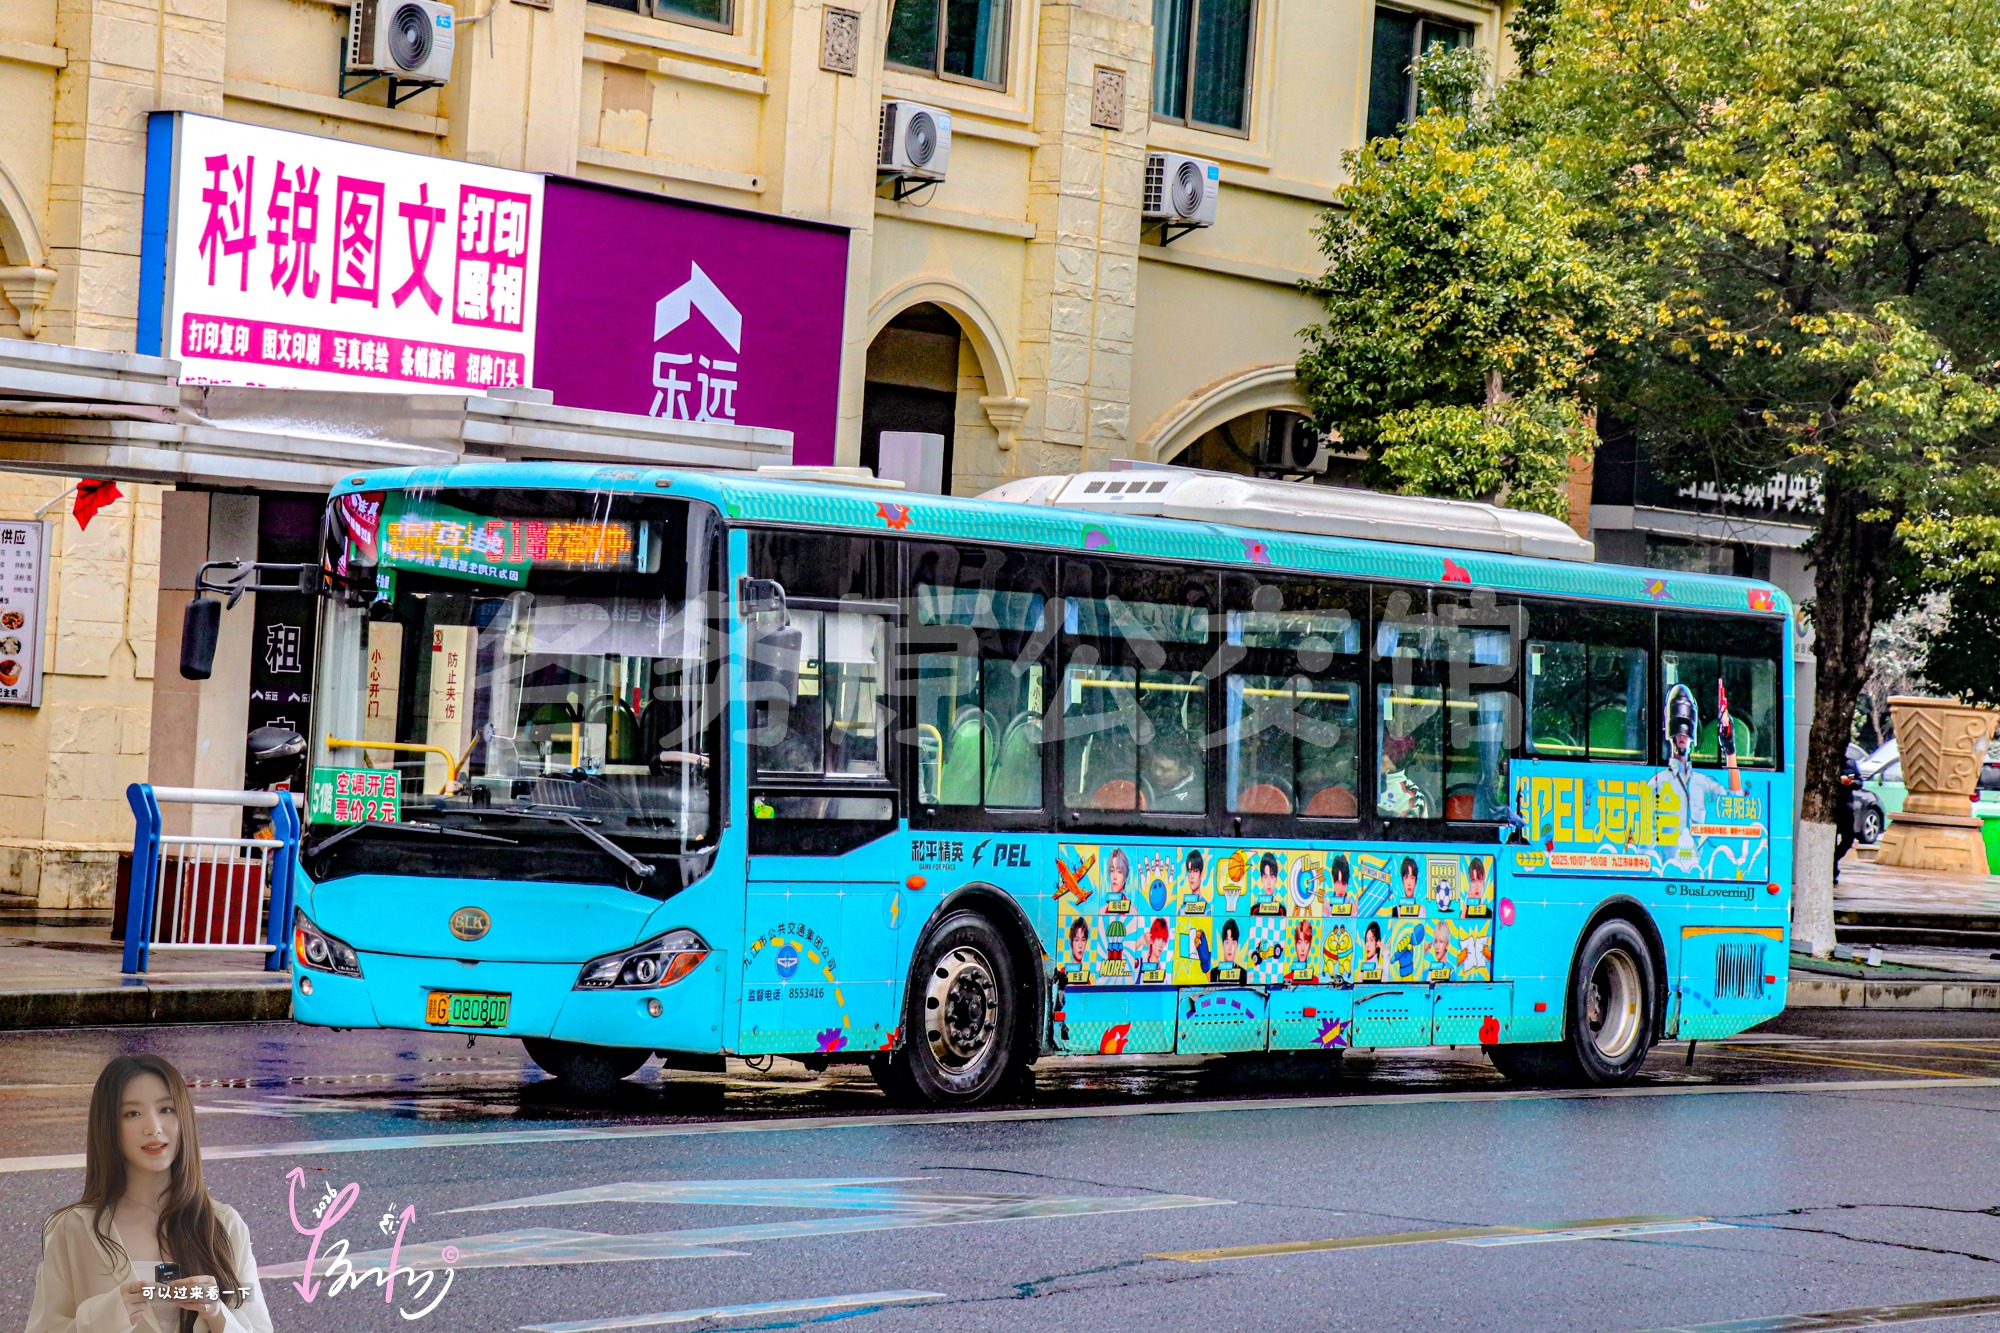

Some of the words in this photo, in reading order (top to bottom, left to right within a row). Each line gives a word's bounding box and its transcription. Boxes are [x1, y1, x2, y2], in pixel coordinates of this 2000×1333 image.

[198, 153, 447, 317] 科锐图文
[461, 192, 529, 259] 打印
[455, 257, 525, 325] 照相
[188, 318, 250, 357] 打印复印
[261, 325, 322, 367] 图文印刷
[333, 334, 391, 375] 写真喷绘
[466, 352, 520, 387] 招牌门头
[649, 351, 738, 425] 乐远
[1, 529, 26, 545] 供应
[264, 622, 302, 674] 租
[367, 648, 383, 719] 小心开门
[444, 651, 459, 720] 防止夹伤
[311, 782, 334, 815] 51路
[336, 773, 398, 799] 空调开启
[334, 797, 397, 824] 票价2元
[911, 839, 964, 862] 和平精英
[919, 863, 931, 871] GAME
[932, 863, 942, 871] FOR
[992, 843, 1032, 868] PEL
[1550, 855, 1608, 868] 2025.10/07-10/08
[454, 914, 486, 930] BLK
[742, 921, 837, 972] 九江市公共交通集团公司
[788, 987, 825, 999] 8553416
